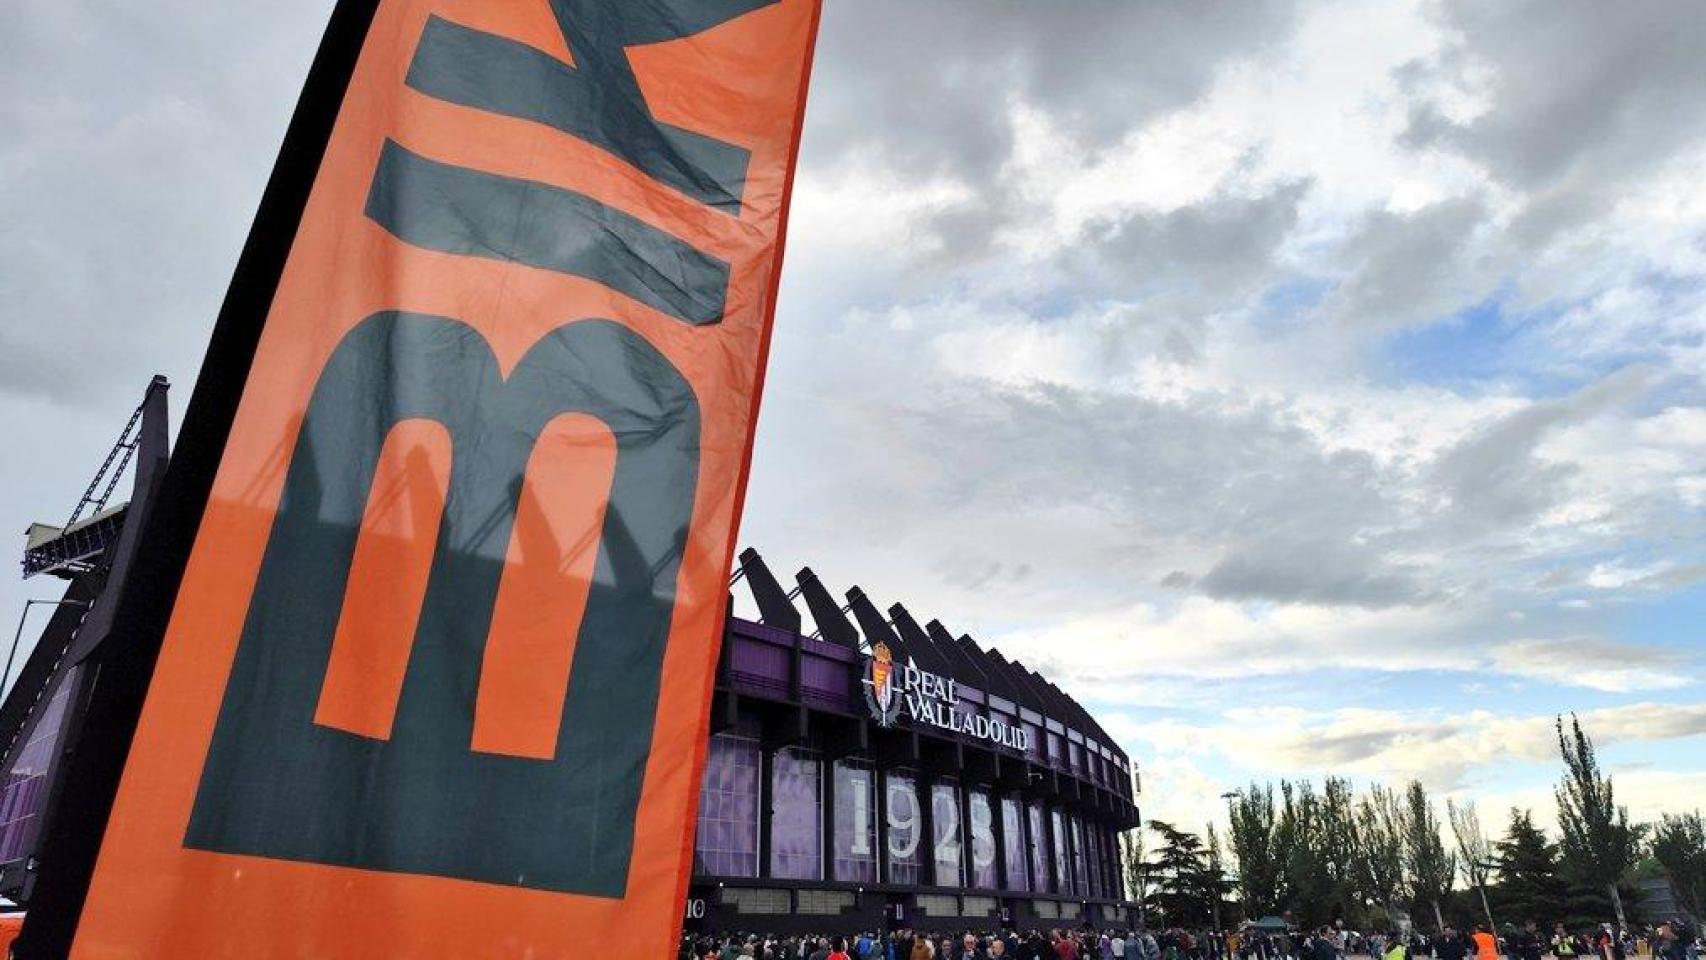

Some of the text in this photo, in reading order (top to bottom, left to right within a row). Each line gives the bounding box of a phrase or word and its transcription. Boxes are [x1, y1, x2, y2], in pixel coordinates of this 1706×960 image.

[904, 665, 960, 704] REAL
[905, 693, 1028, 751] VALLADOLID
[850, 779, 996, 867] 1928
[686, 899, 705, 918] 10
